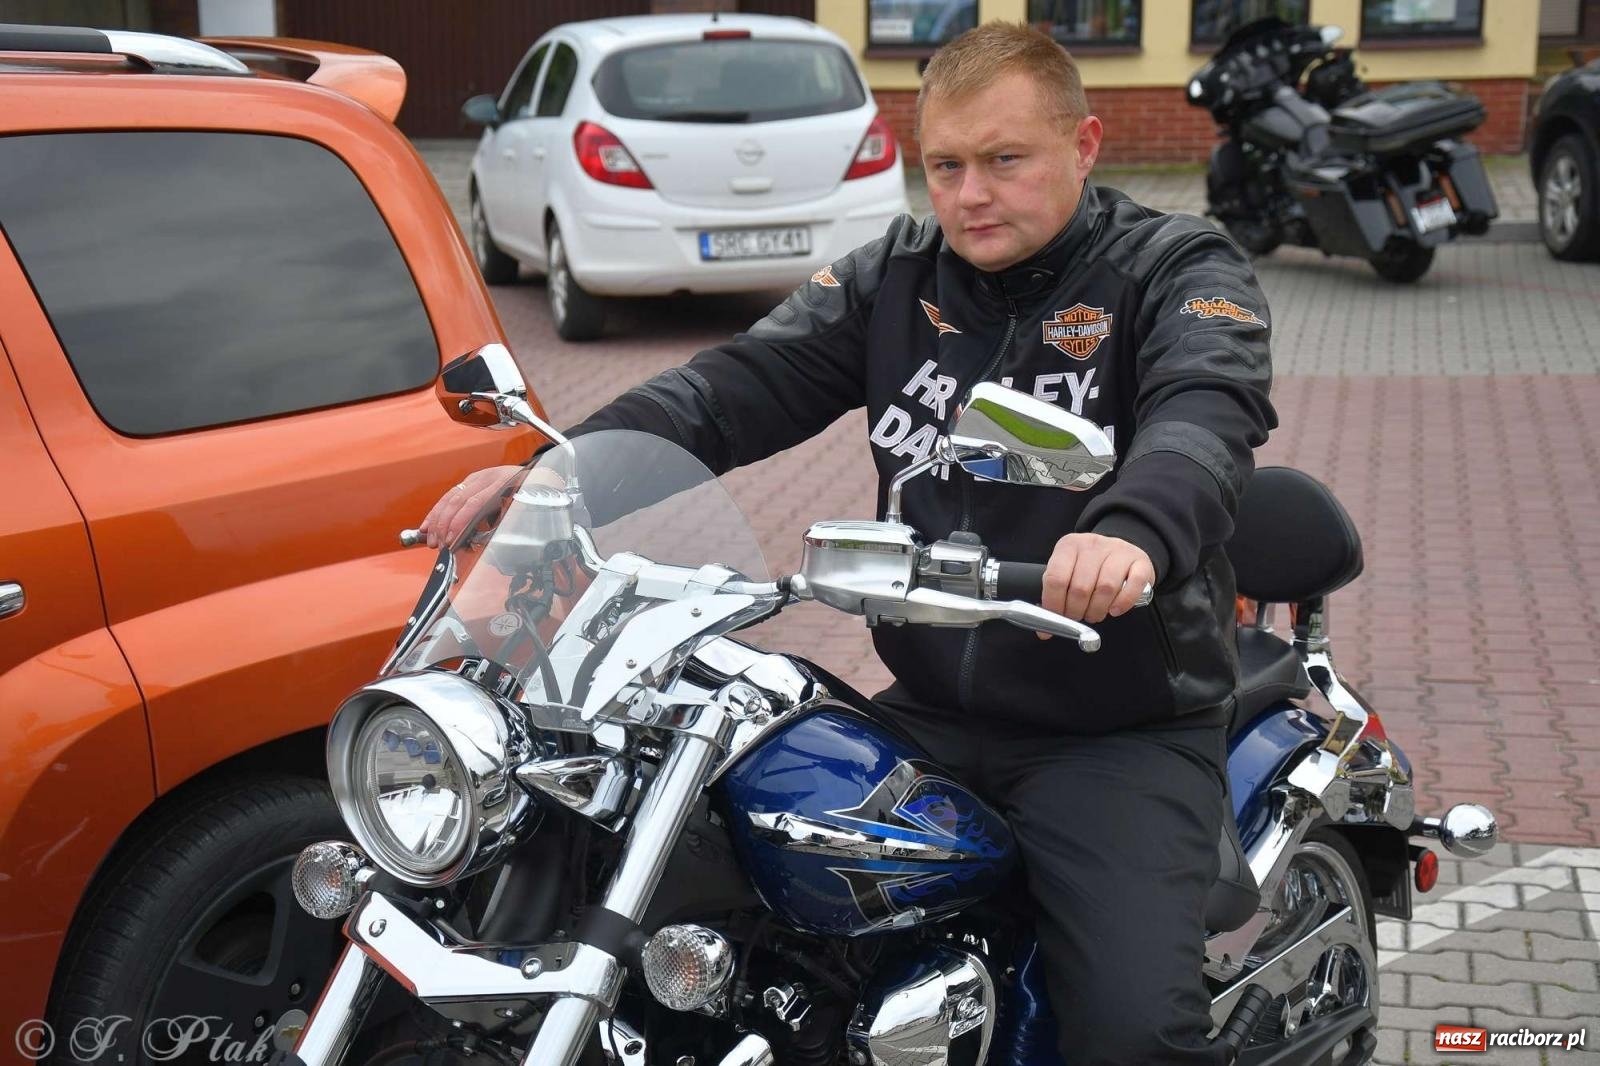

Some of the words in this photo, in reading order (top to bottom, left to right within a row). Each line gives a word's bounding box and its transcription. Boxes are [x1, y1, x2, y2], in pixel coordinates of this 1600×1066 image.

[1064, 309, 1097, 322] MOTOR
[1047, 320, 1108, 339] HARLEY-DAVIDSON
[1063, 337, 1096, 354] CYCLES
